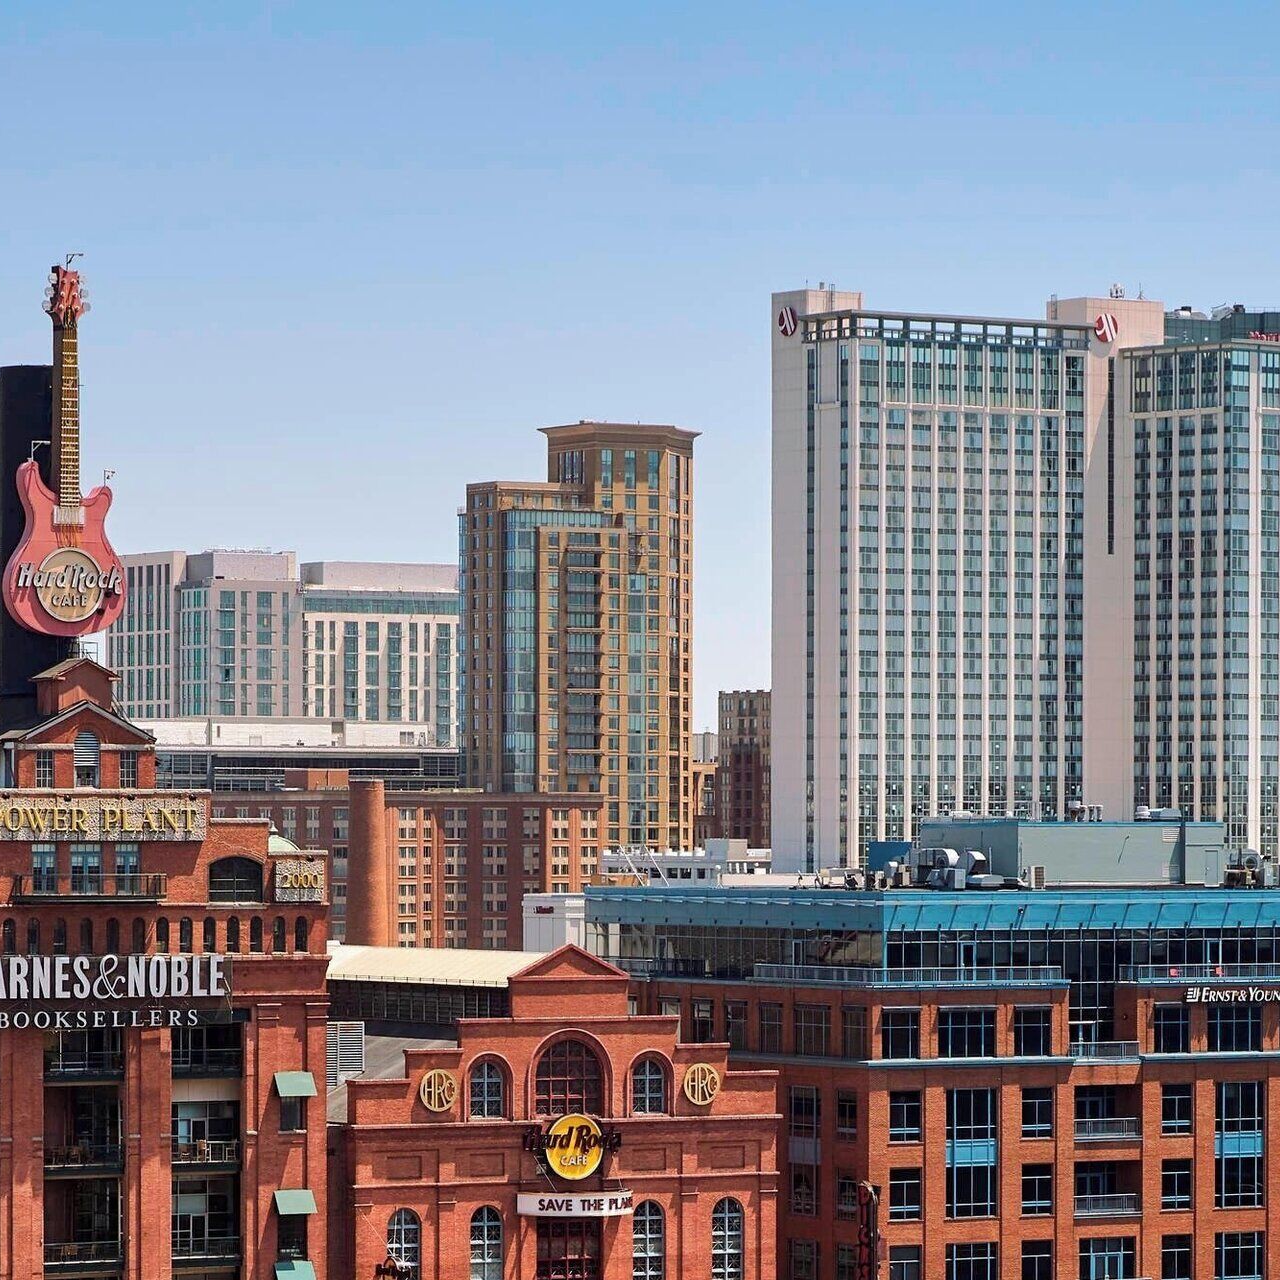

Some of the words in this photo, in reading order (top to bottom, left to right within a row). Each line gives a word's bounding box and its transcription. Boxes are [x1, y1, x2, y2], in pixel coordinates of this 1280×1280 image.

[18, 563, 73, 588] Hard
[71, 563, 122, 595] Rock
[52, 594, 88, 607] CAFE
[102, 807, 197, 833] PLANT
[282, 874, 321, 888] 2000
[560, 1155, 588, 1166] CAFE
[538, 1199, 572, 1211] SAVE
[580, 1198, 604, 1211] THE
